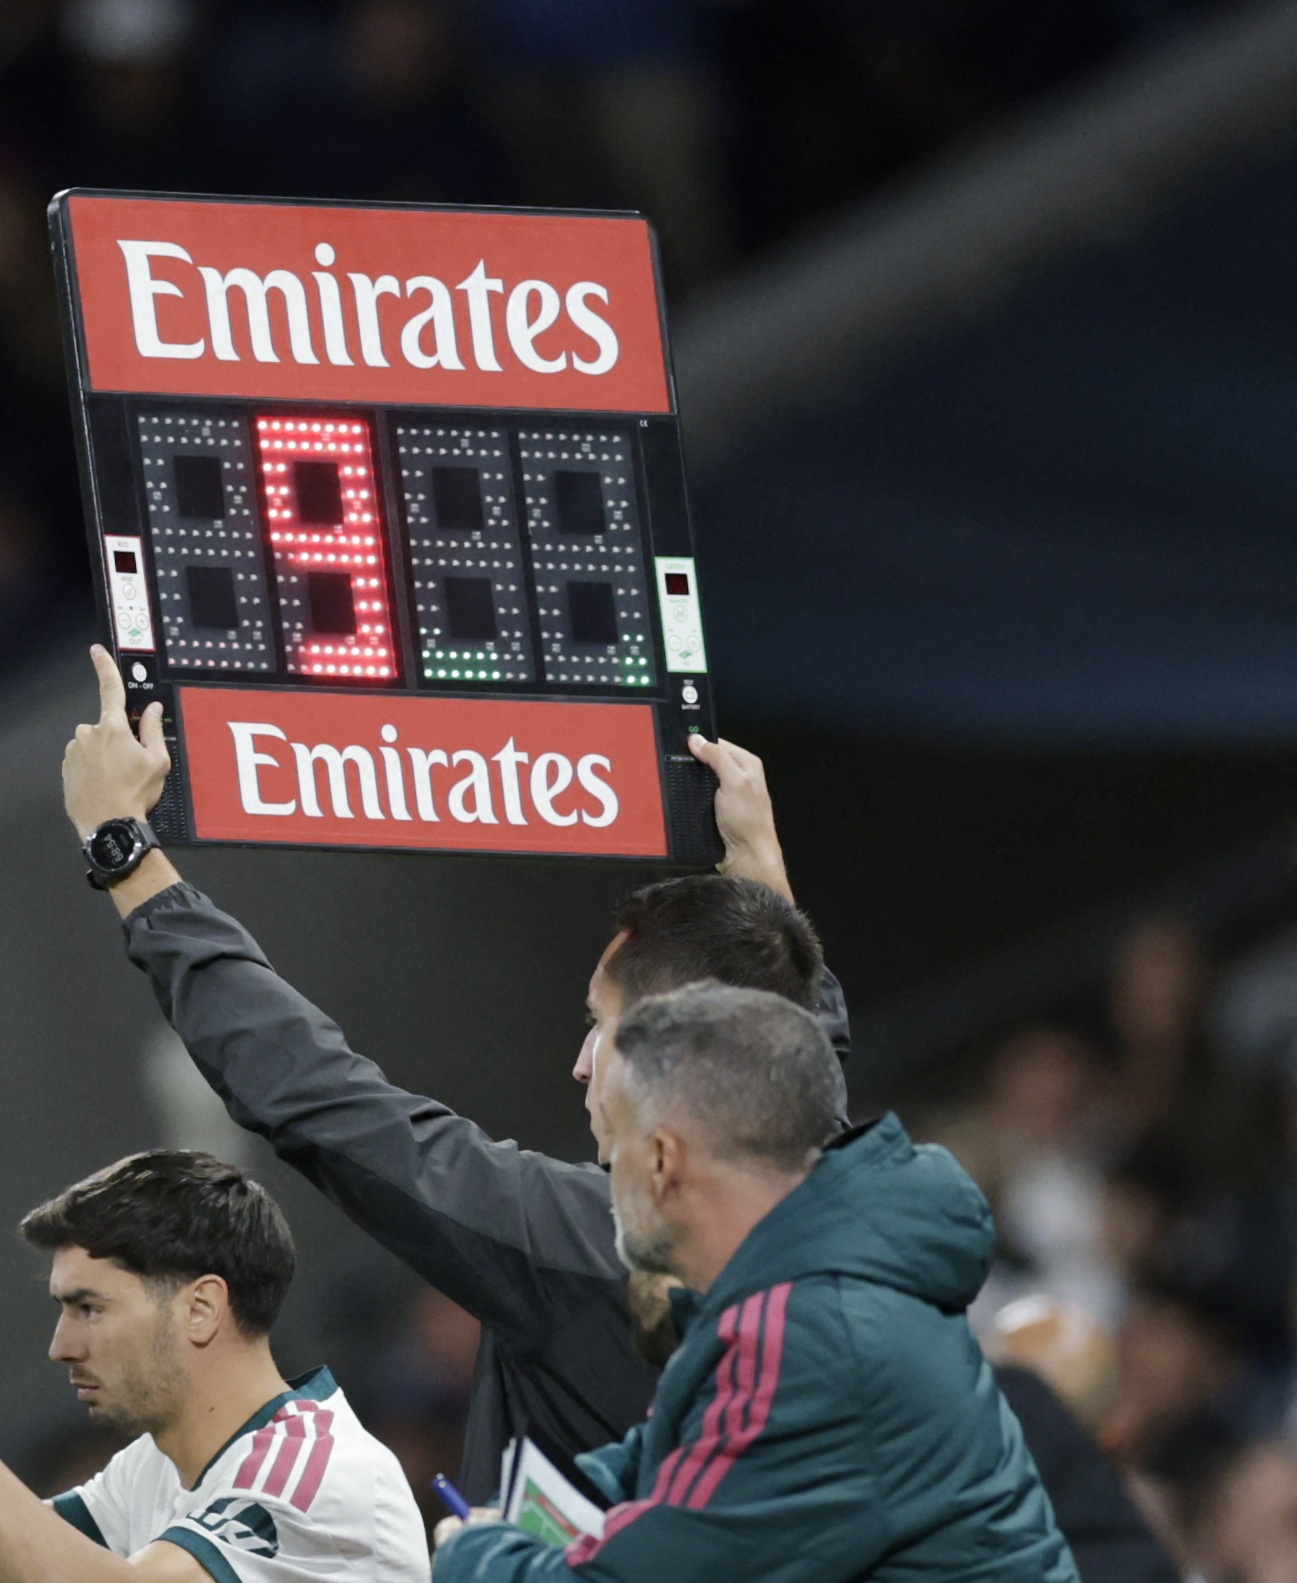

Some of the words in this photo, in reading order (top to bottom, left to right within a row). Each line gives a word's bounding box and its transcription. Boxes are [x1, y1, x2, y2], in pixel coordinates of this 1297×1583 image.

[116, 239, 620, 376] Emirates
[257, 416, 397, 679] 9
[127, 682, 139, 690] ON
[142, 682, 155, 690] OFF
[227, 721, 620, 829] Emirates
